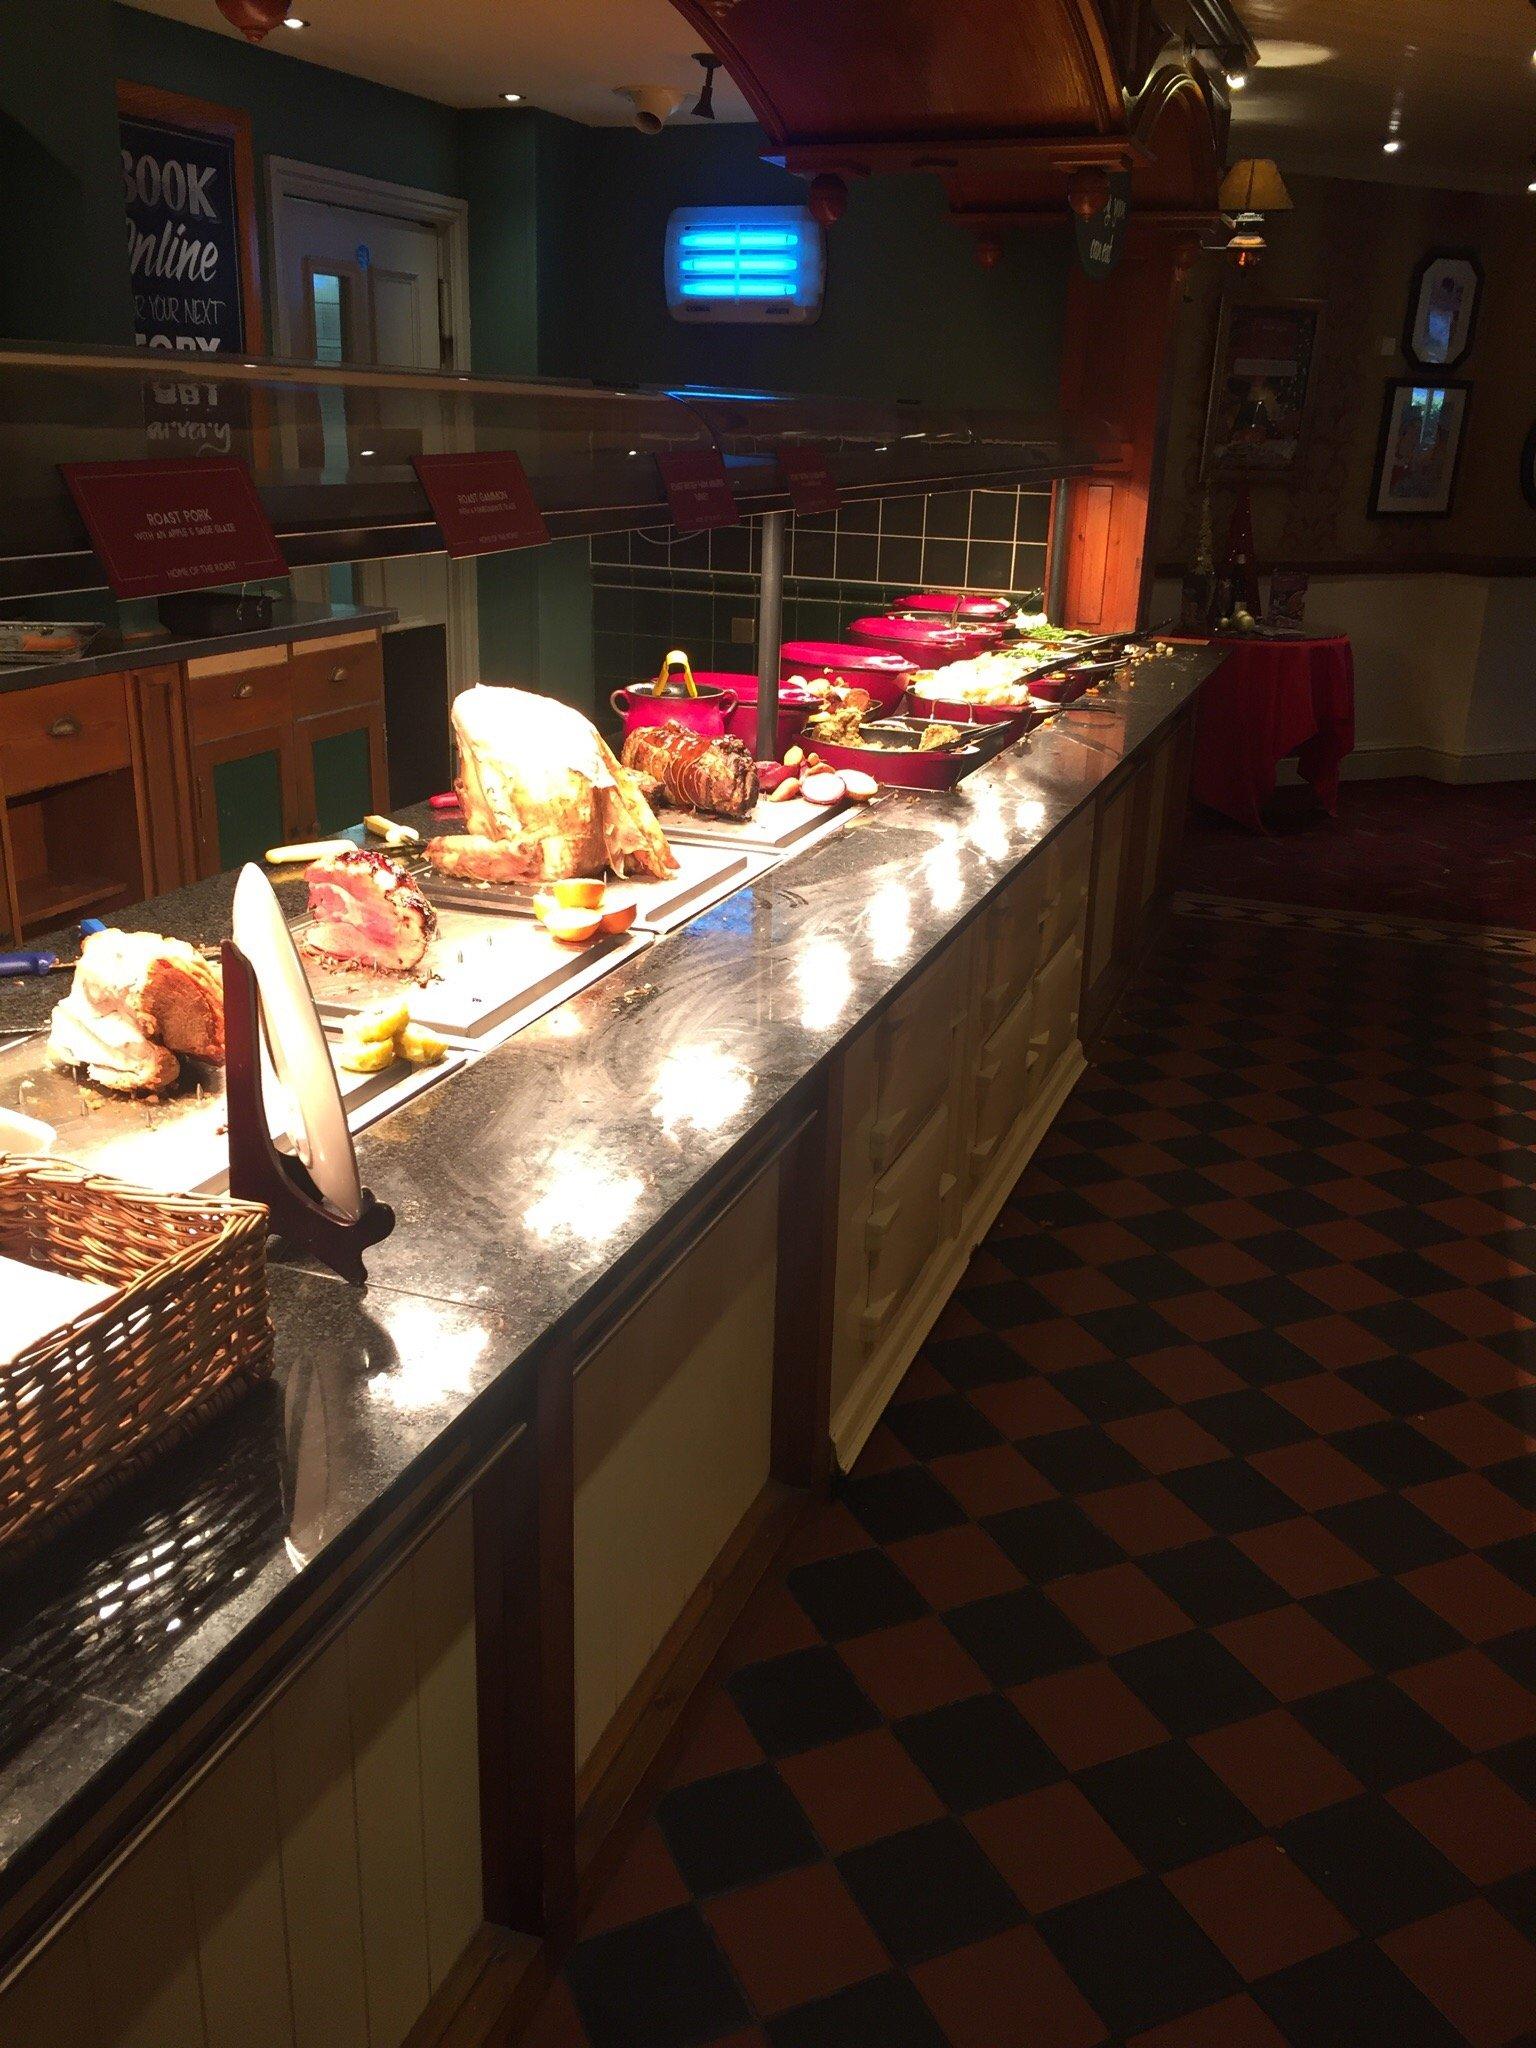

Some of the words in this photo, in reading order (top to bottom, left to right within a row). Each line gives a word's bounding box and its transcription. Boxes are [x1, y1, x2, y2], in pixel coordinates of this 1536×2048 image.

[149, 293, 179, 324] YOUR
[184, 295, 226, 326] NEXT
[145, 420, 231, 457] arvery
[146, 511, 181, 527] ROAST
[183, 508, 213, 523] PORK
[134, 530, 154, 541] WITH
[156, 529, 167, 540] AN
[168, 528, 188, 539] APPLE
[195, 524, 214, 536] SAGE
[215, 522, 236, 534] GLAZE
[166, 566, 188, 579] HOME
[188, 565, 199, 577] OF
[199, 562, 214, 576] THE
[214, 560, 238, 573] ROAST
